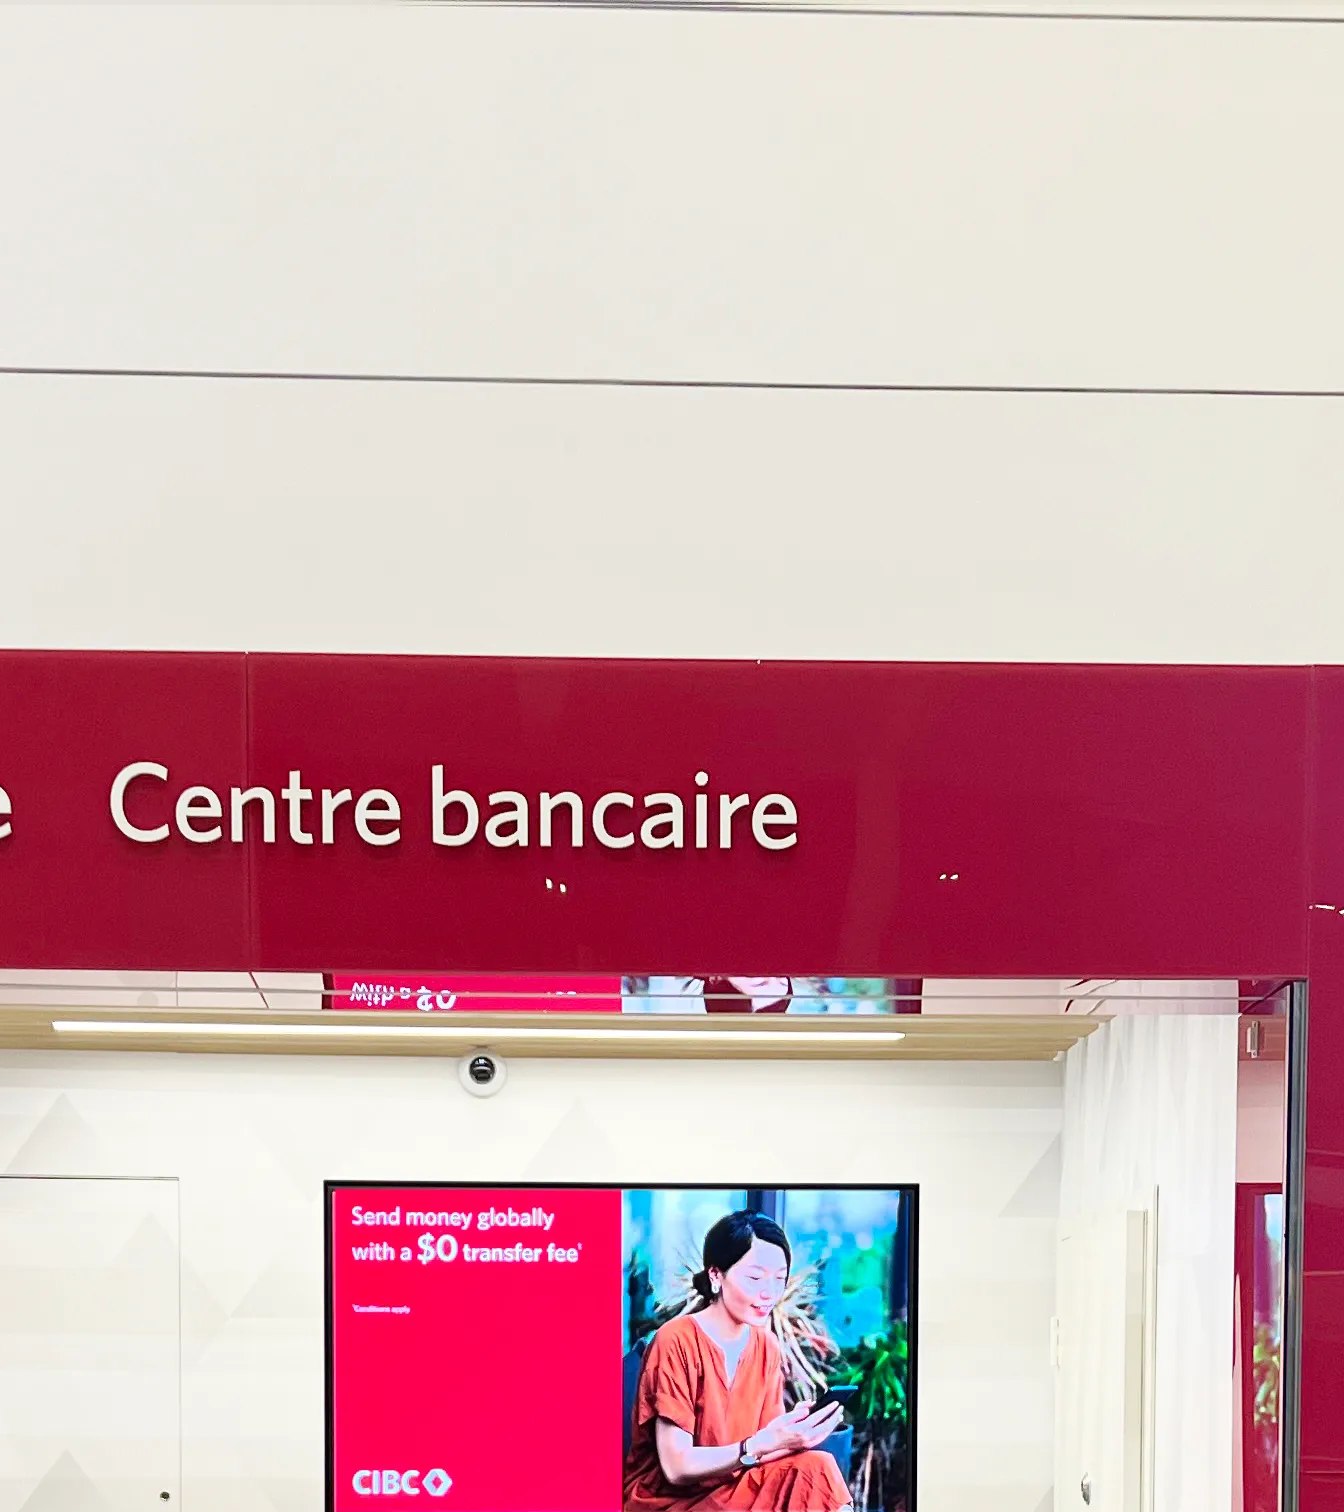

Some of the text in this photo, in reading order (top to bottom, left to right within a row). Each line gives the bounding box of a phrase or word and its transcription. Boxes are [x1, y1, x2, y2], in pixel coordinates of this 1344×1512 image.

[109, 761, 798, 851] Centre bancaire
[351, 1206, 555, 1231] Send money globally
[351, 1242, 396, 1261] with
[400, 1246, 413, 1261] a
[417, 1232, 459, 1265] $0
[462, 1243, 543, 1262] transfer
[352, 1470, 420, 1495] CIBC
